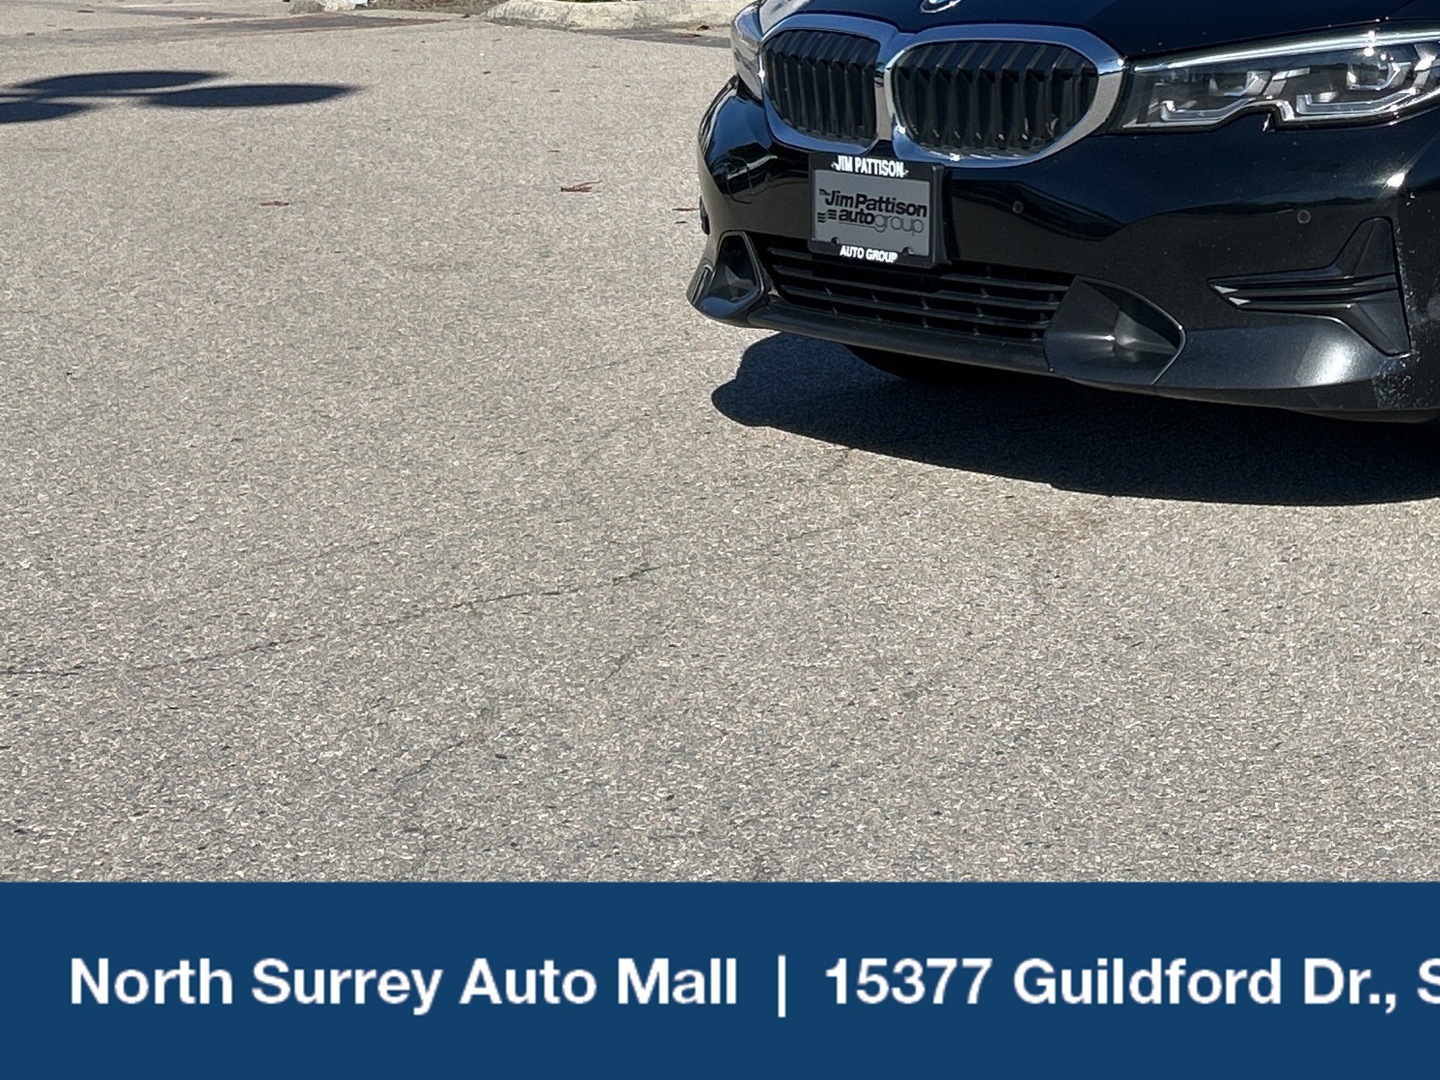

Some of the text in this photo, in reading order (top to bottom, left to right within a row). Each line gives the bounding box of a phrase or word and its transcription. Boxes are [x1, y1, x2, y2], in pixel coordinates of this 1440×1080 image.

[835, 155, 904, 178] JIM PATTISON
[840, 245, 898, 263] AUTO GROUP
